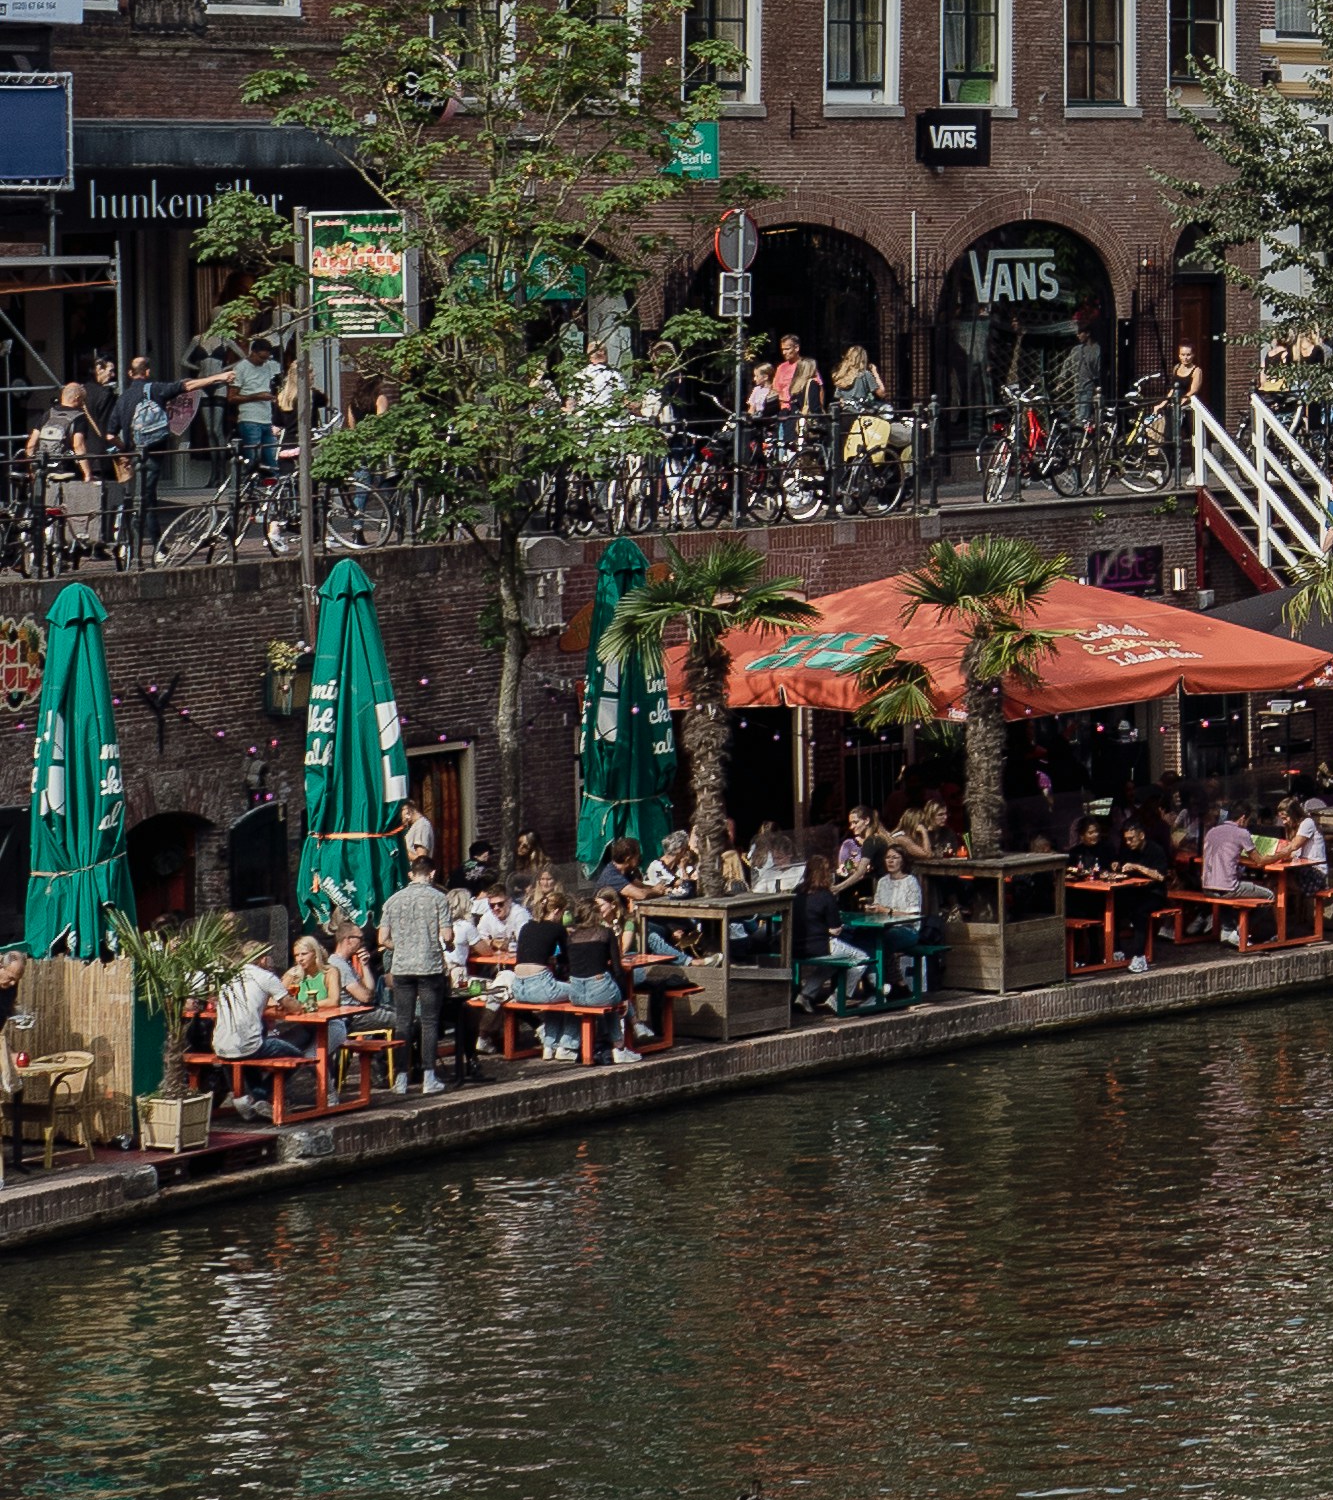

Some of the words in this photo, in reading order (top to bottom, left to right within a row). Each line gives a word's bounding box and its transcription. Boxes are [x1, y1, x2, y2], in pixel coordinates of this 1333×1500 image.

[929, 125, 977, 149] VANS
[89, 178, 284, 219] hunkemr
[968, 248, 1059, 303] VANS
